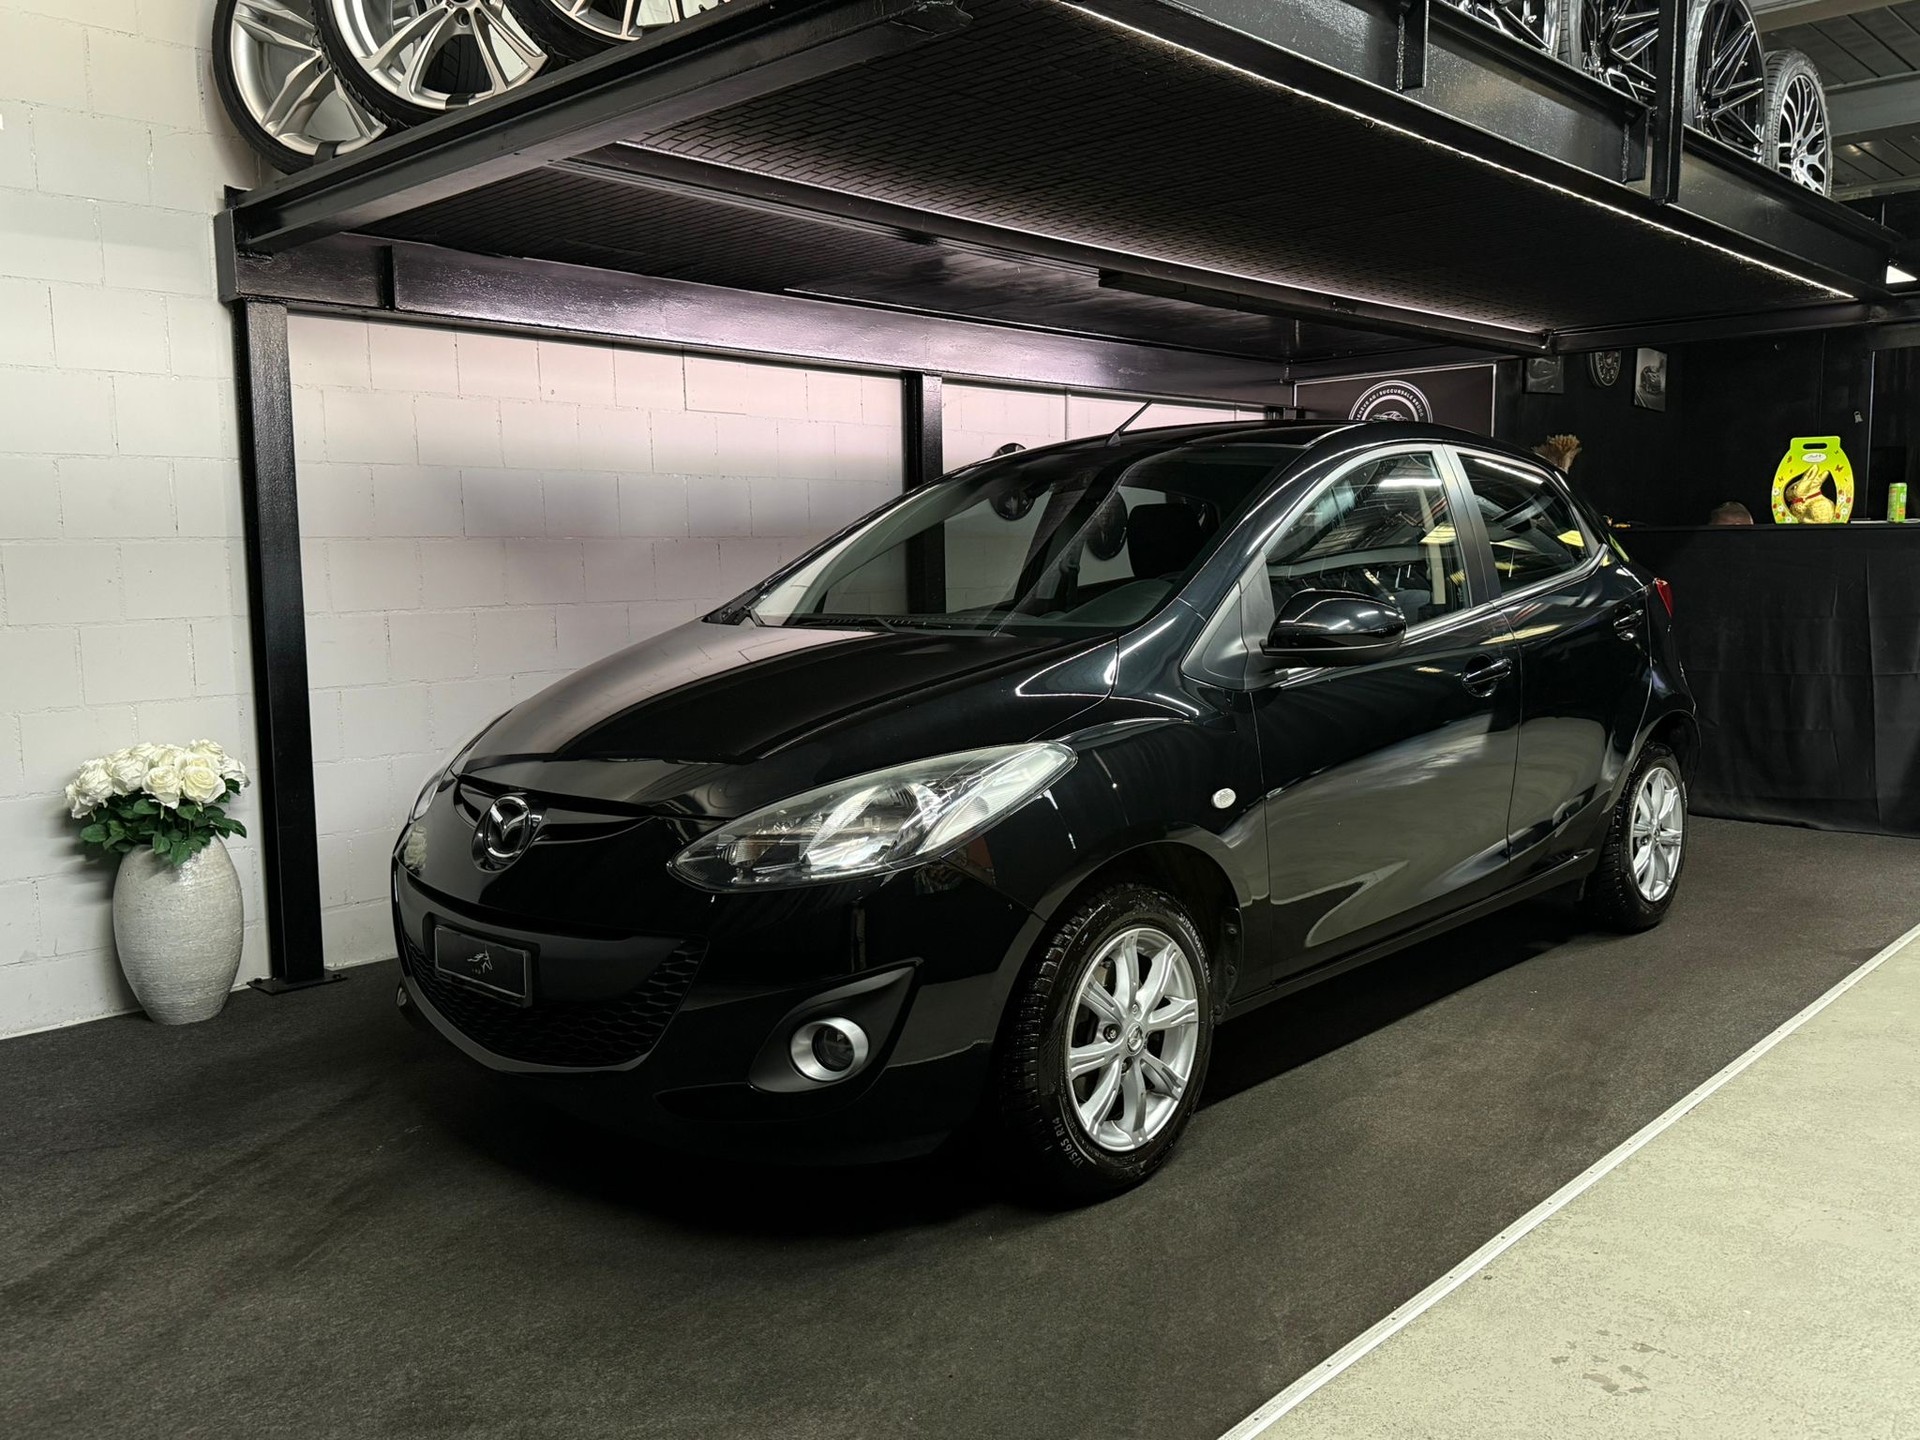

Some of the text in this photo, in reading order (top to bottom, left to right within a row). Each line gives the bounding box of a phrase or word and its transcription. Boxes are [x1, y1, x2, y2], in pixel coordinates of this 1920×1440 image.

[1379, 388, 1414, 400] SUCCURSALE
[1052, 1116, 1065, 1138] R14
[1060, 1138, 1084, 1168] 175/65
